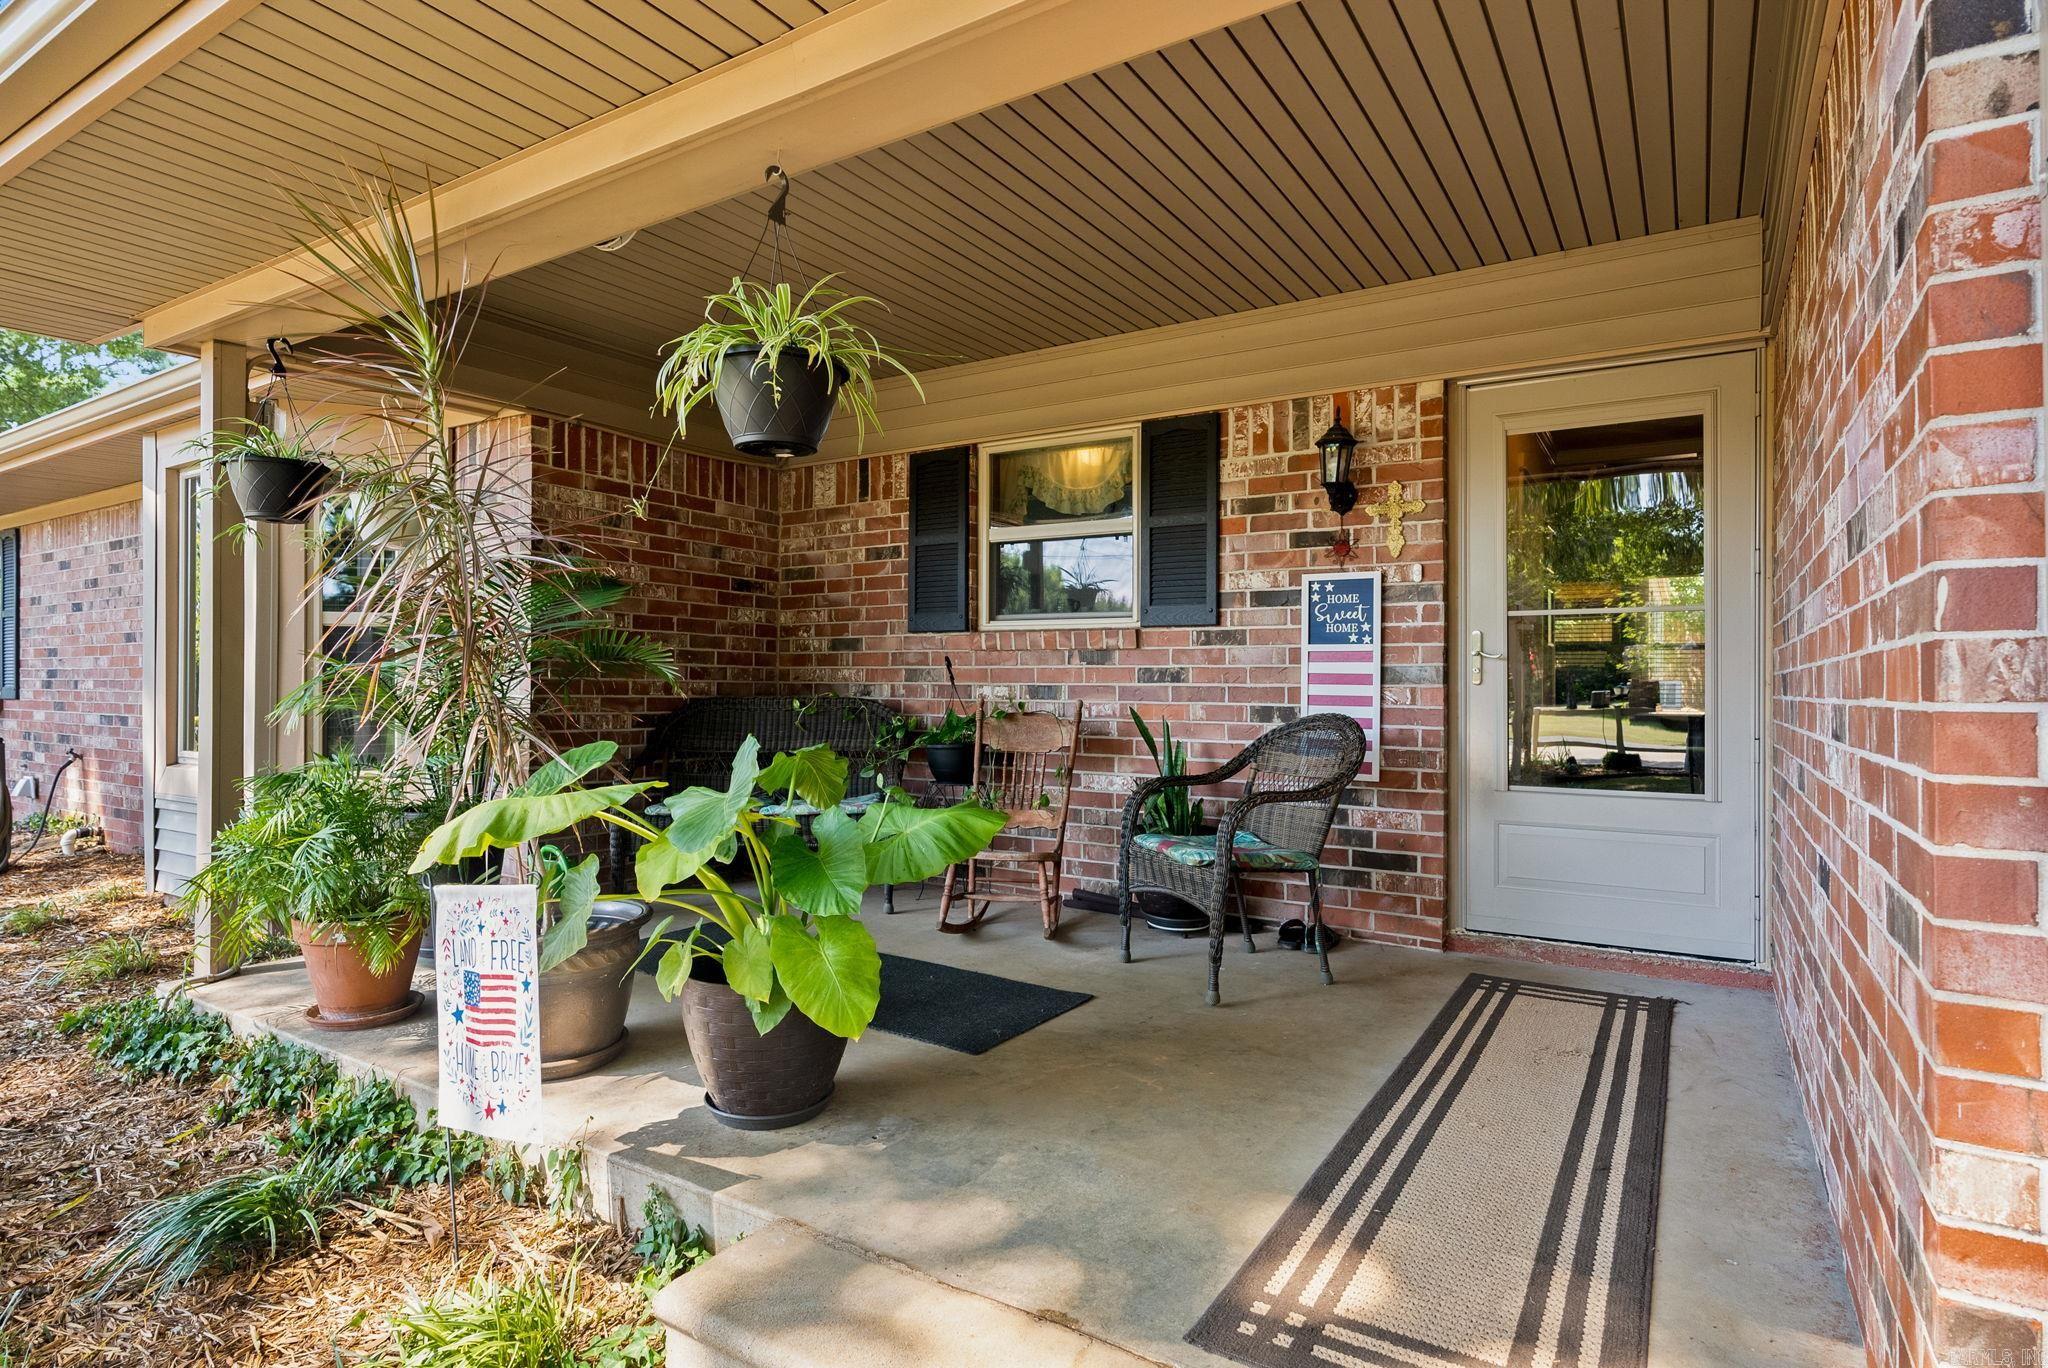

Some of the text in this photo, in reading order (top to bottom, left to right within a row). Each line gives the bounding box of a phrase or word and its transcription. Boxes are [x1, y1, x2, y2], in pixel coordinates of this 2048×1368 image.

[1326, 594, 1360, 604] HOME
[1314, 602, 1371, 624] Sweet
[1325, 623, 1359, 633] HOME
[452, 937, 477, 968] LAND
[490, 939, 526, 974] FREE
[490, 1050, 525, 1085] BRAVE
